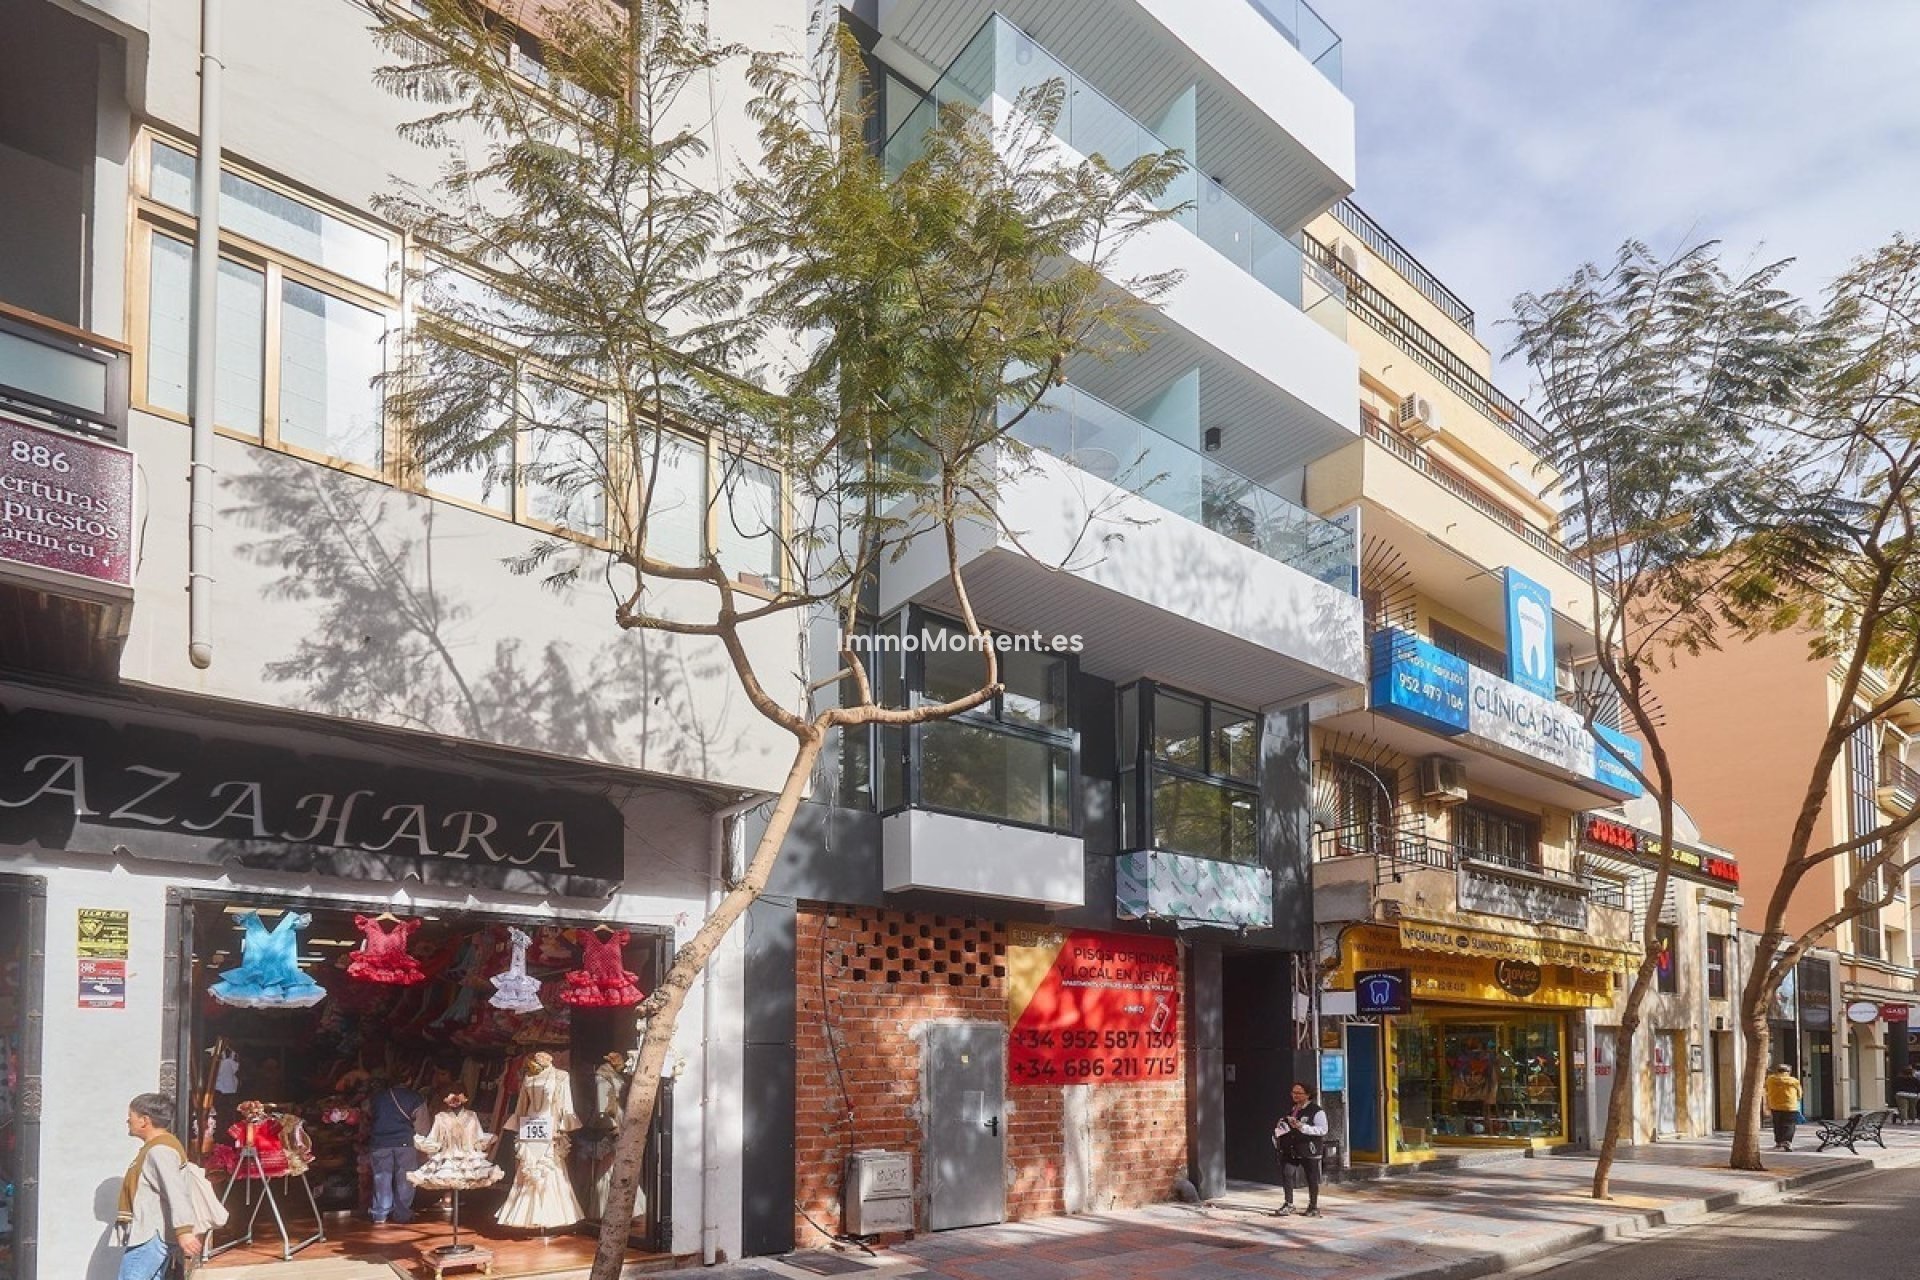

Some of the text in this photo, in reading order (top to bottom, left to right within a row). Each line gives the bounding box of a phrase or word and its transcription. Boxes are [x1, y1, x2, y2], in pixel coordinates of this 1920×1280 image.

[11, 440, 70, 473] 886
[1474, 685, 1538, 732] CLÍNICA
[1542, 714, 1592, 755] DENTAL
[0, 754, 576, 868] AZAHARA
[1058, 966, 1175, 983] Y LOCAL EN VENTA
[1014, 1030, 1176, 1049] +34 952 587 130
[1015, 1057, 1175, 1078] +34 686 211 715
